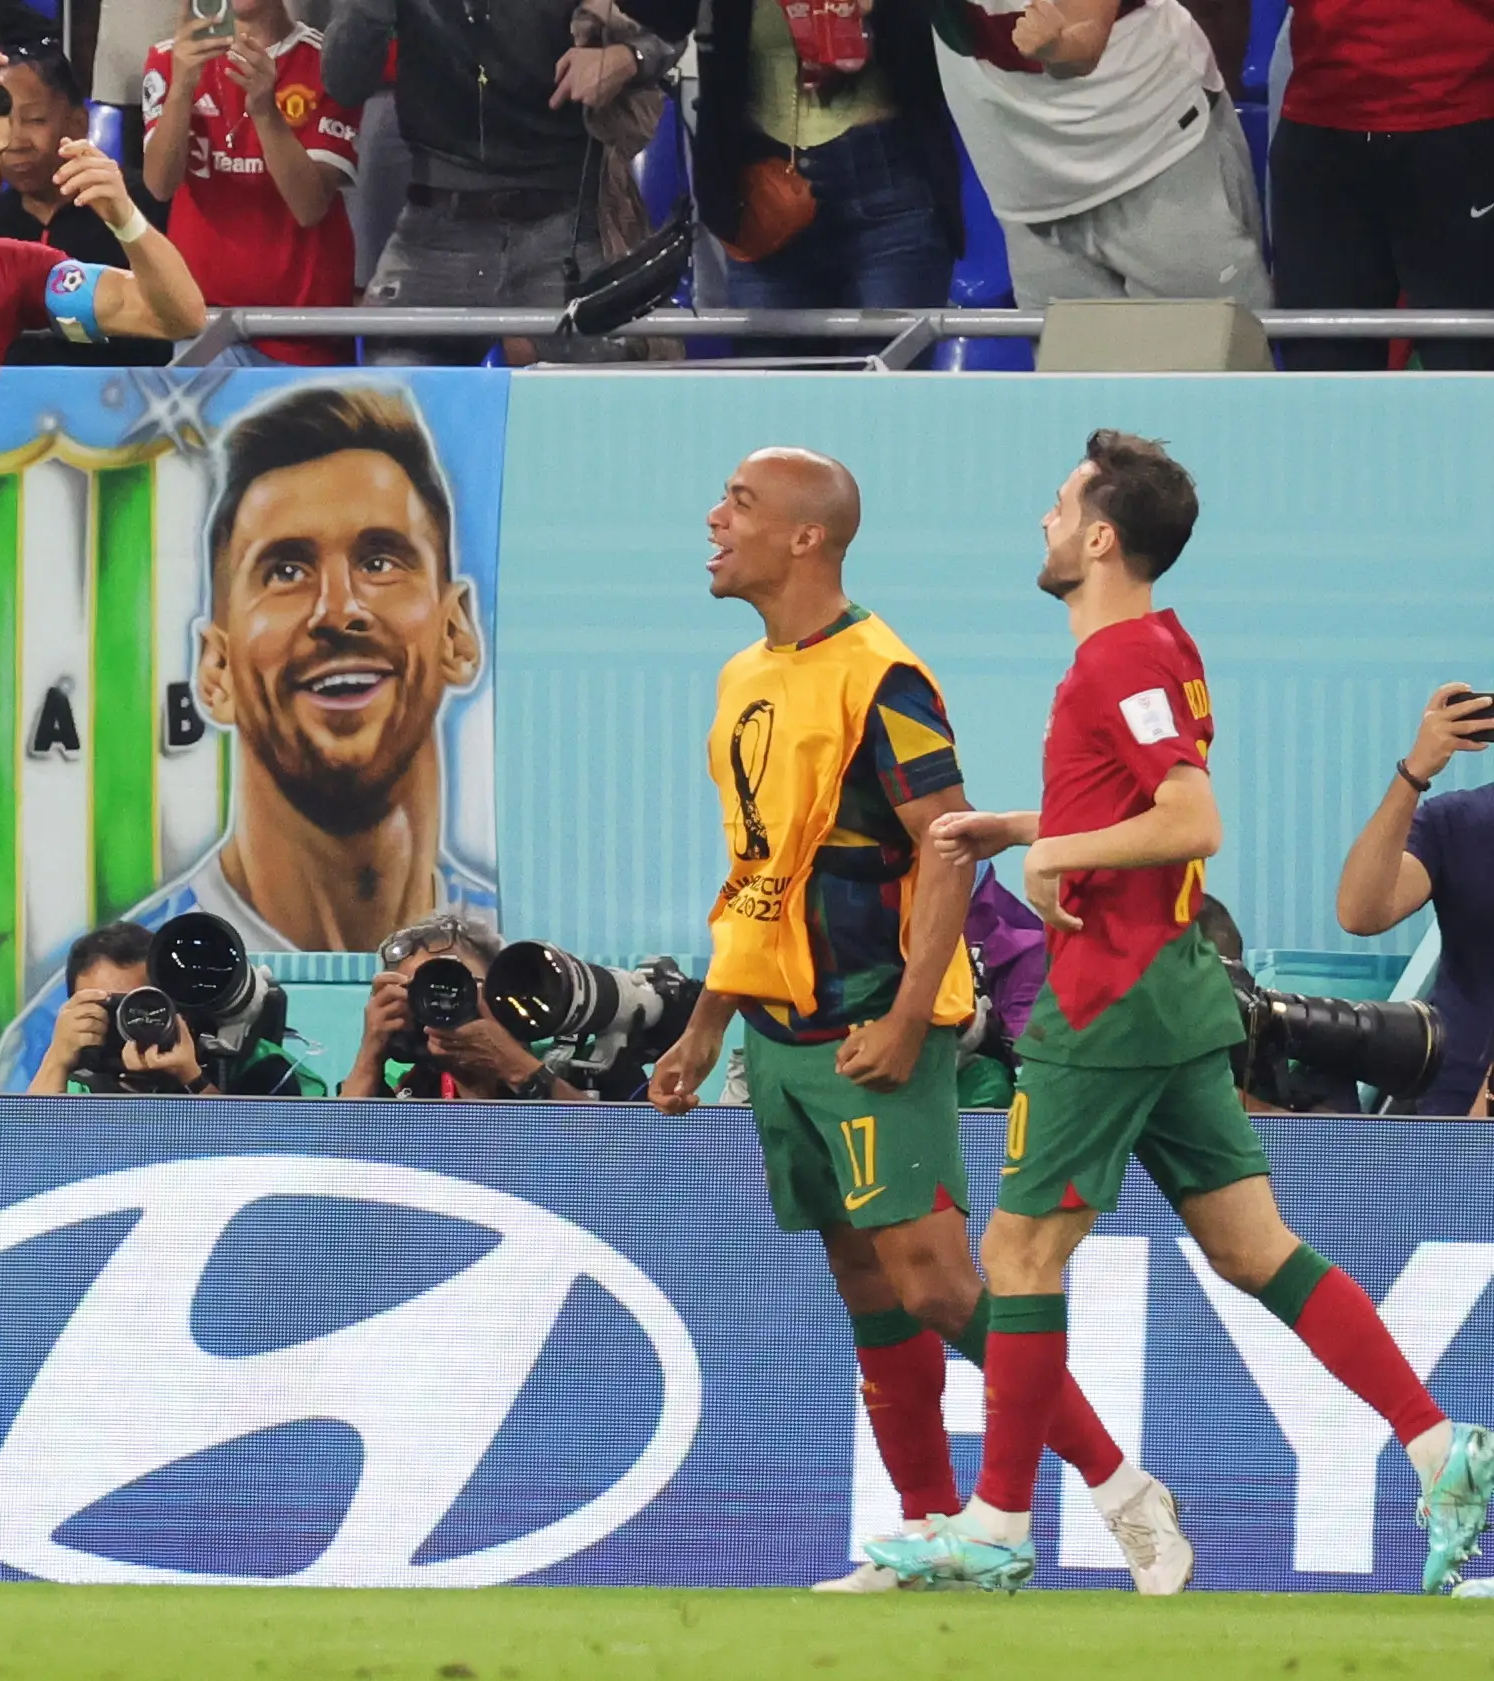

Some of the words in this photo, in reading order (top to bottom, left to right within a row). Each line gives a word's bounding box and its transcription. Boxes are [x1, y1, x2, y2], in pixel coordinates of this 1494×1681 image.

[212, 151, 263, 172] Team
[34, 687, 80, 752] A
[167, 682, 205, 746] B
[840, 1115, 876, 1187] 17
